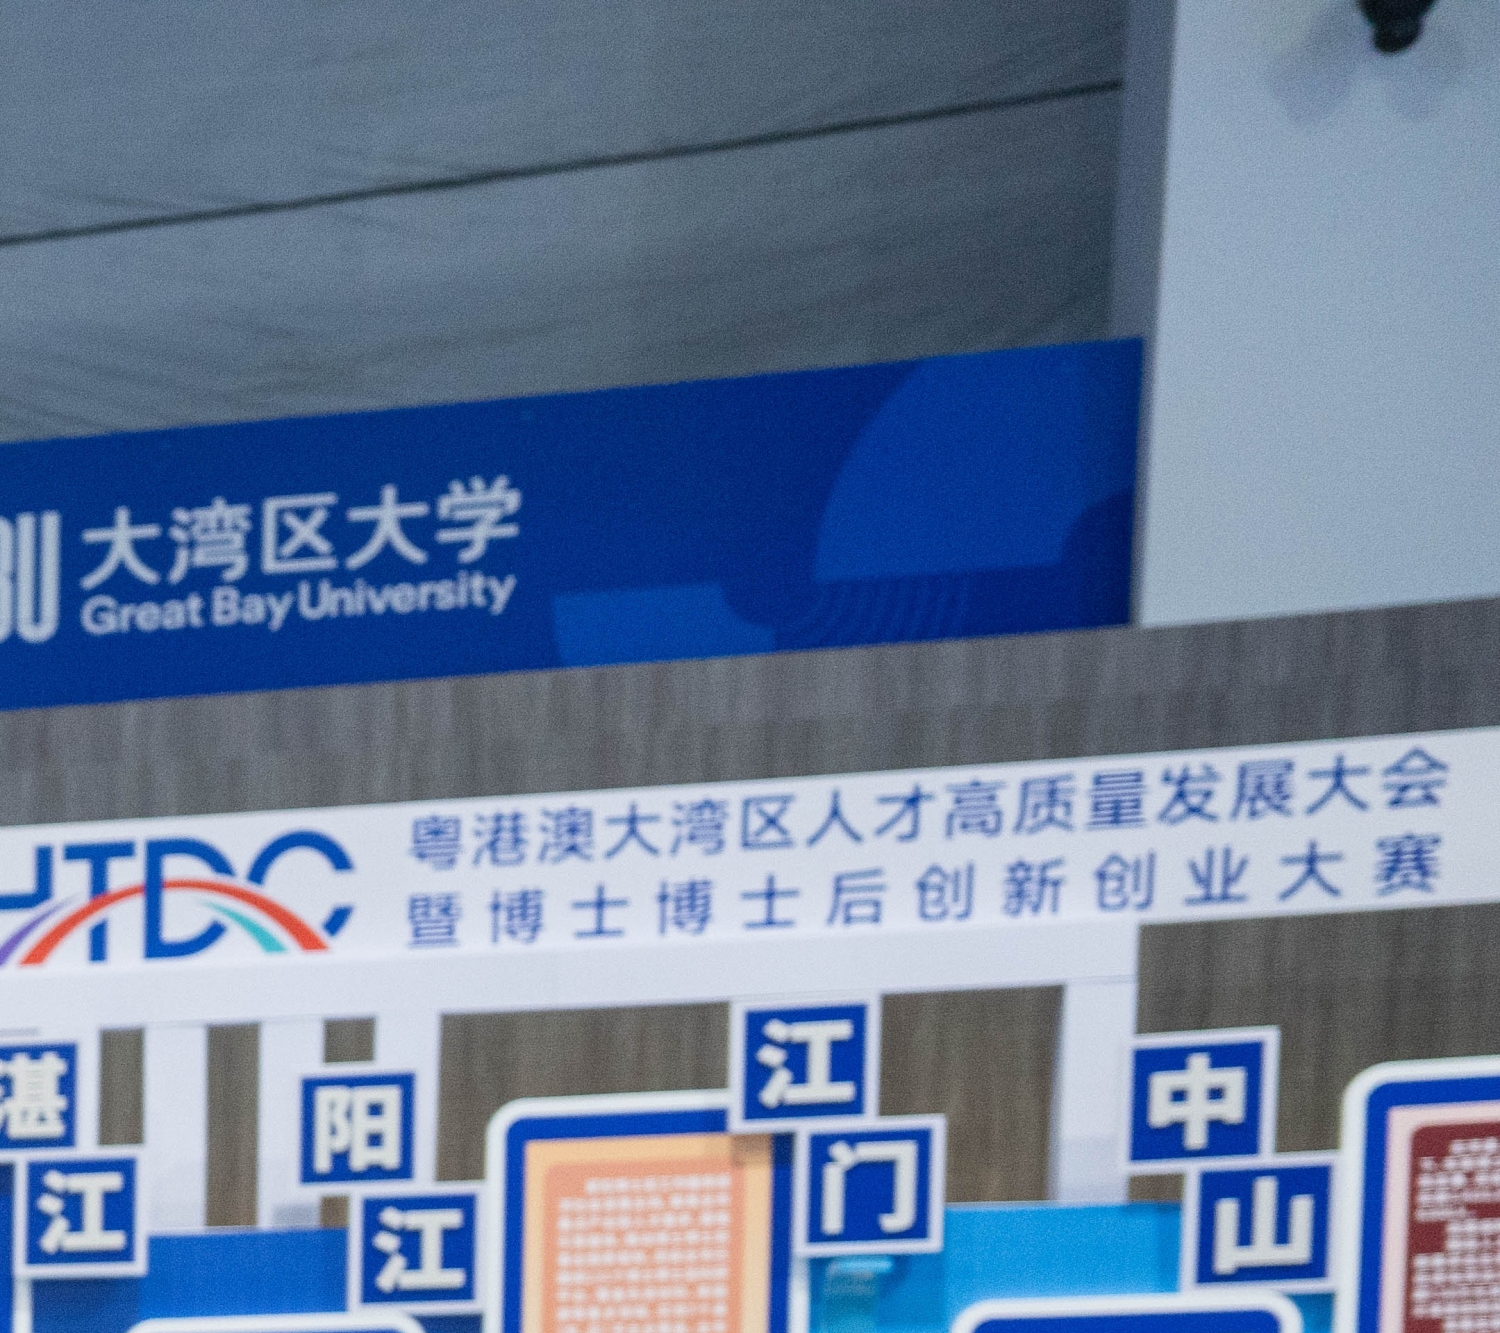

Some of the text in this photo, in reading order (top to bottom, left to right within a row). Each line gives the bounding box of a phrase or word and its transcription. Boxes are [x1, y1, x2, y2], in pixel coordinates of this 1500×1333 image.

[80, 475, 522, 589] 大湾区大学
[80, 569, 518, 636] Great Bay University
[408, 746, 1450, 871] 粤港澳大湾区人才高质量发展大会
[406, 832, 1444, 949] 暨博士博士后创新创业大赛
